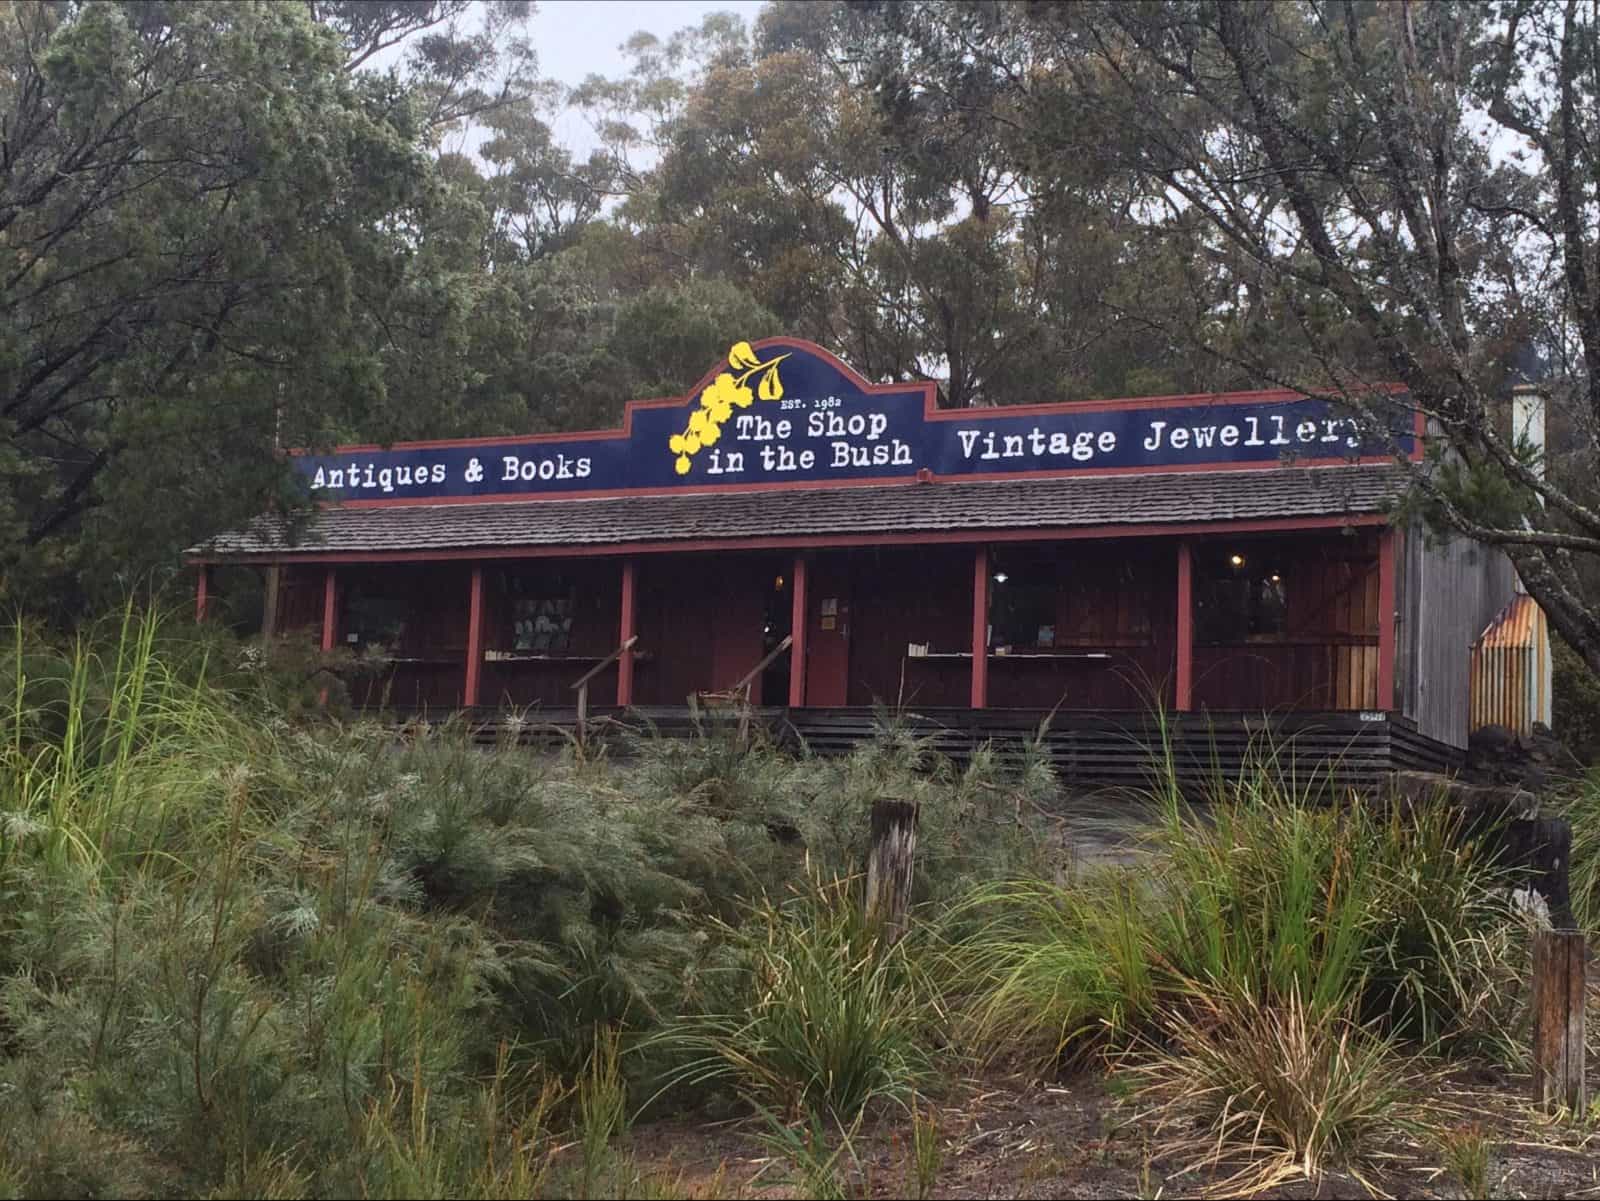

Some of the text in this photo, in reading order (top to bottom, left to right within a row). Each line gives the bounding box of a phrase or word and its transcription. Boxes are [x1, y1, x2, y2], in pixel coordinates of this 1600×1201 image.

[779, 396, 842, 411] EST. 1982
[736, 411, 888, 440] The Shop
[707, 439, 913, 474] in the Bush
[957, 428, 1116, 461] Vintage
[310, 454, 592, 492] Antiques & Books
